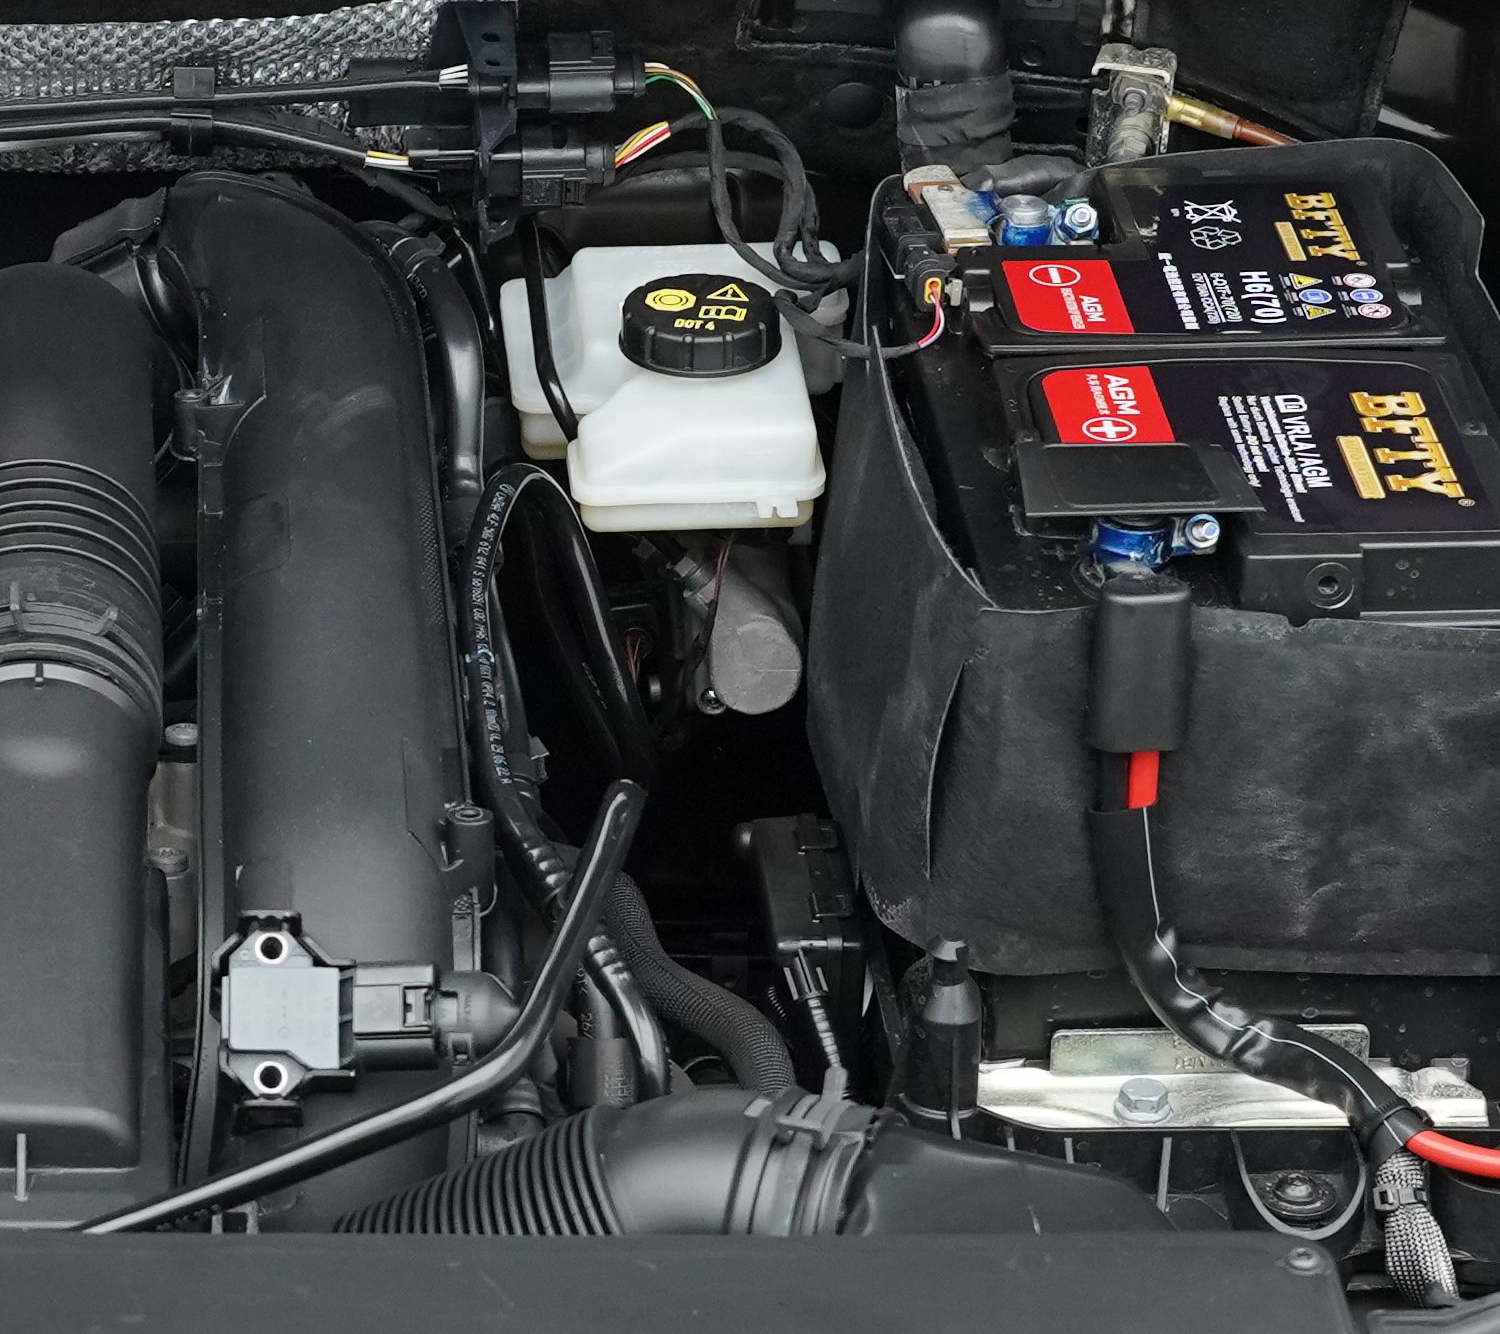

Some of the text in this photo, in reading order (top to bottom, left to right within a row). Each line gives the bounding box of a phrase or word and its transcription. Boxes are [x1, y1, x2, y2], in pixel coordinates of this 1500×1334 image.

[1283, 193, 1361, 260] BFTY
[1079, 295, 1106, 322] AGM
[1239, 271, 1286, 323] H6(70)
[674, 318, 703, 330] DOT
[1104, 374, 1140, 415] AGM
[1282, 416, 1332, 488] VRLA/AGM
[1349, 392, 1466, 498] BFTY
